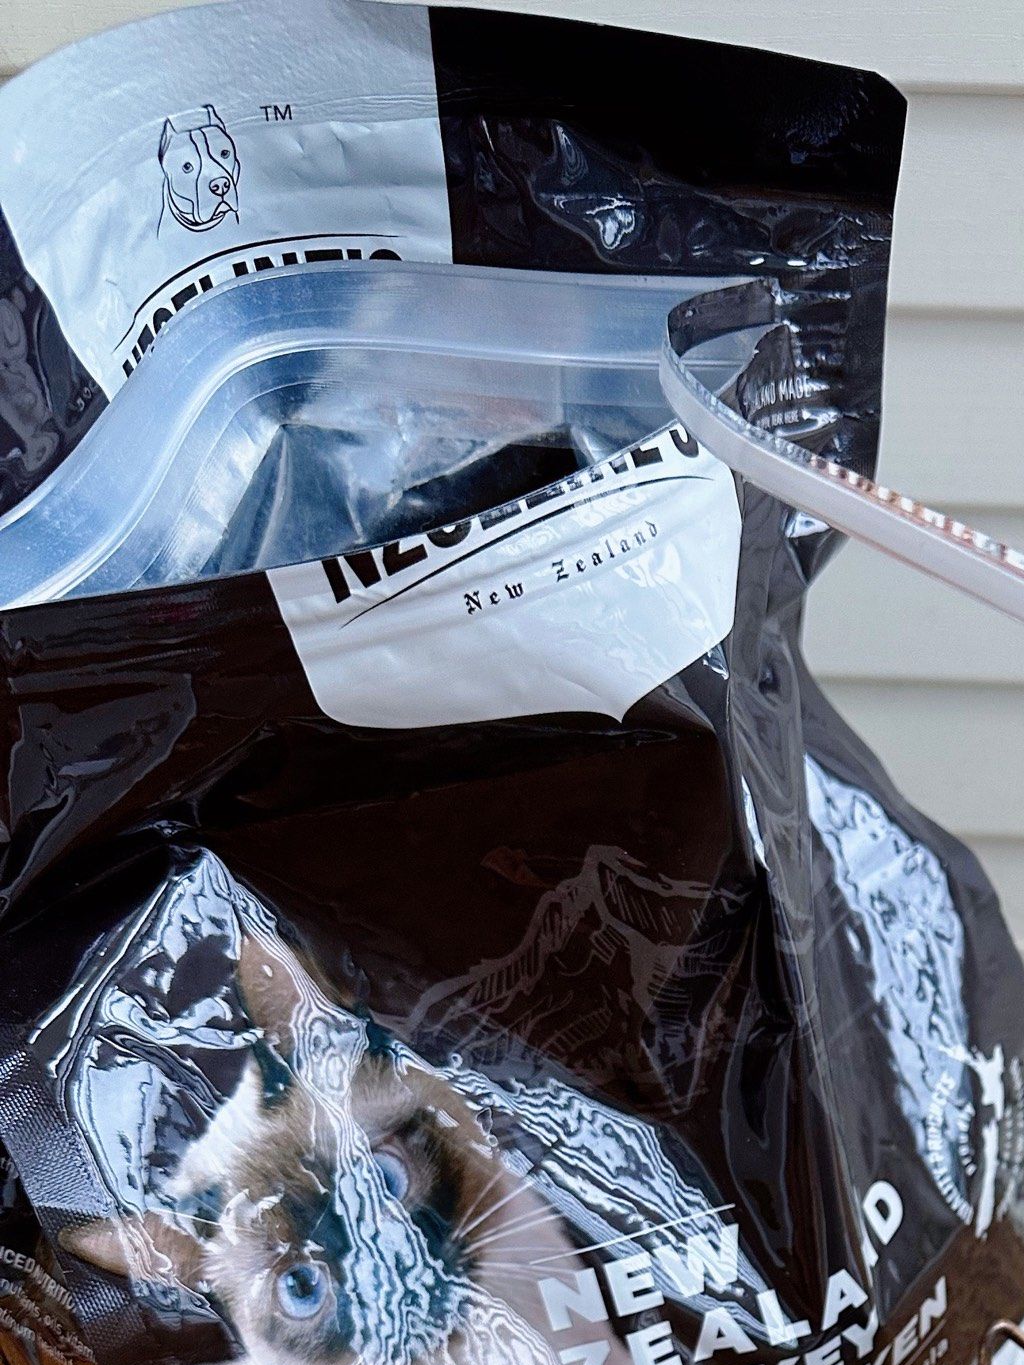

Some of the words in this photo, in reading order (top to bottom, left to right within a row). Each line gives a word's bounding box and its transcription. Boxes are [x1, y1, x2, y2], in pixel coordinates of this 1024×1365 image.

[259, 104, 293, 122] TM
[463, 582, 525, 615] New
[551, 520, 658, 583] Zealand
[538, 1223, 740, 1332] NEW
